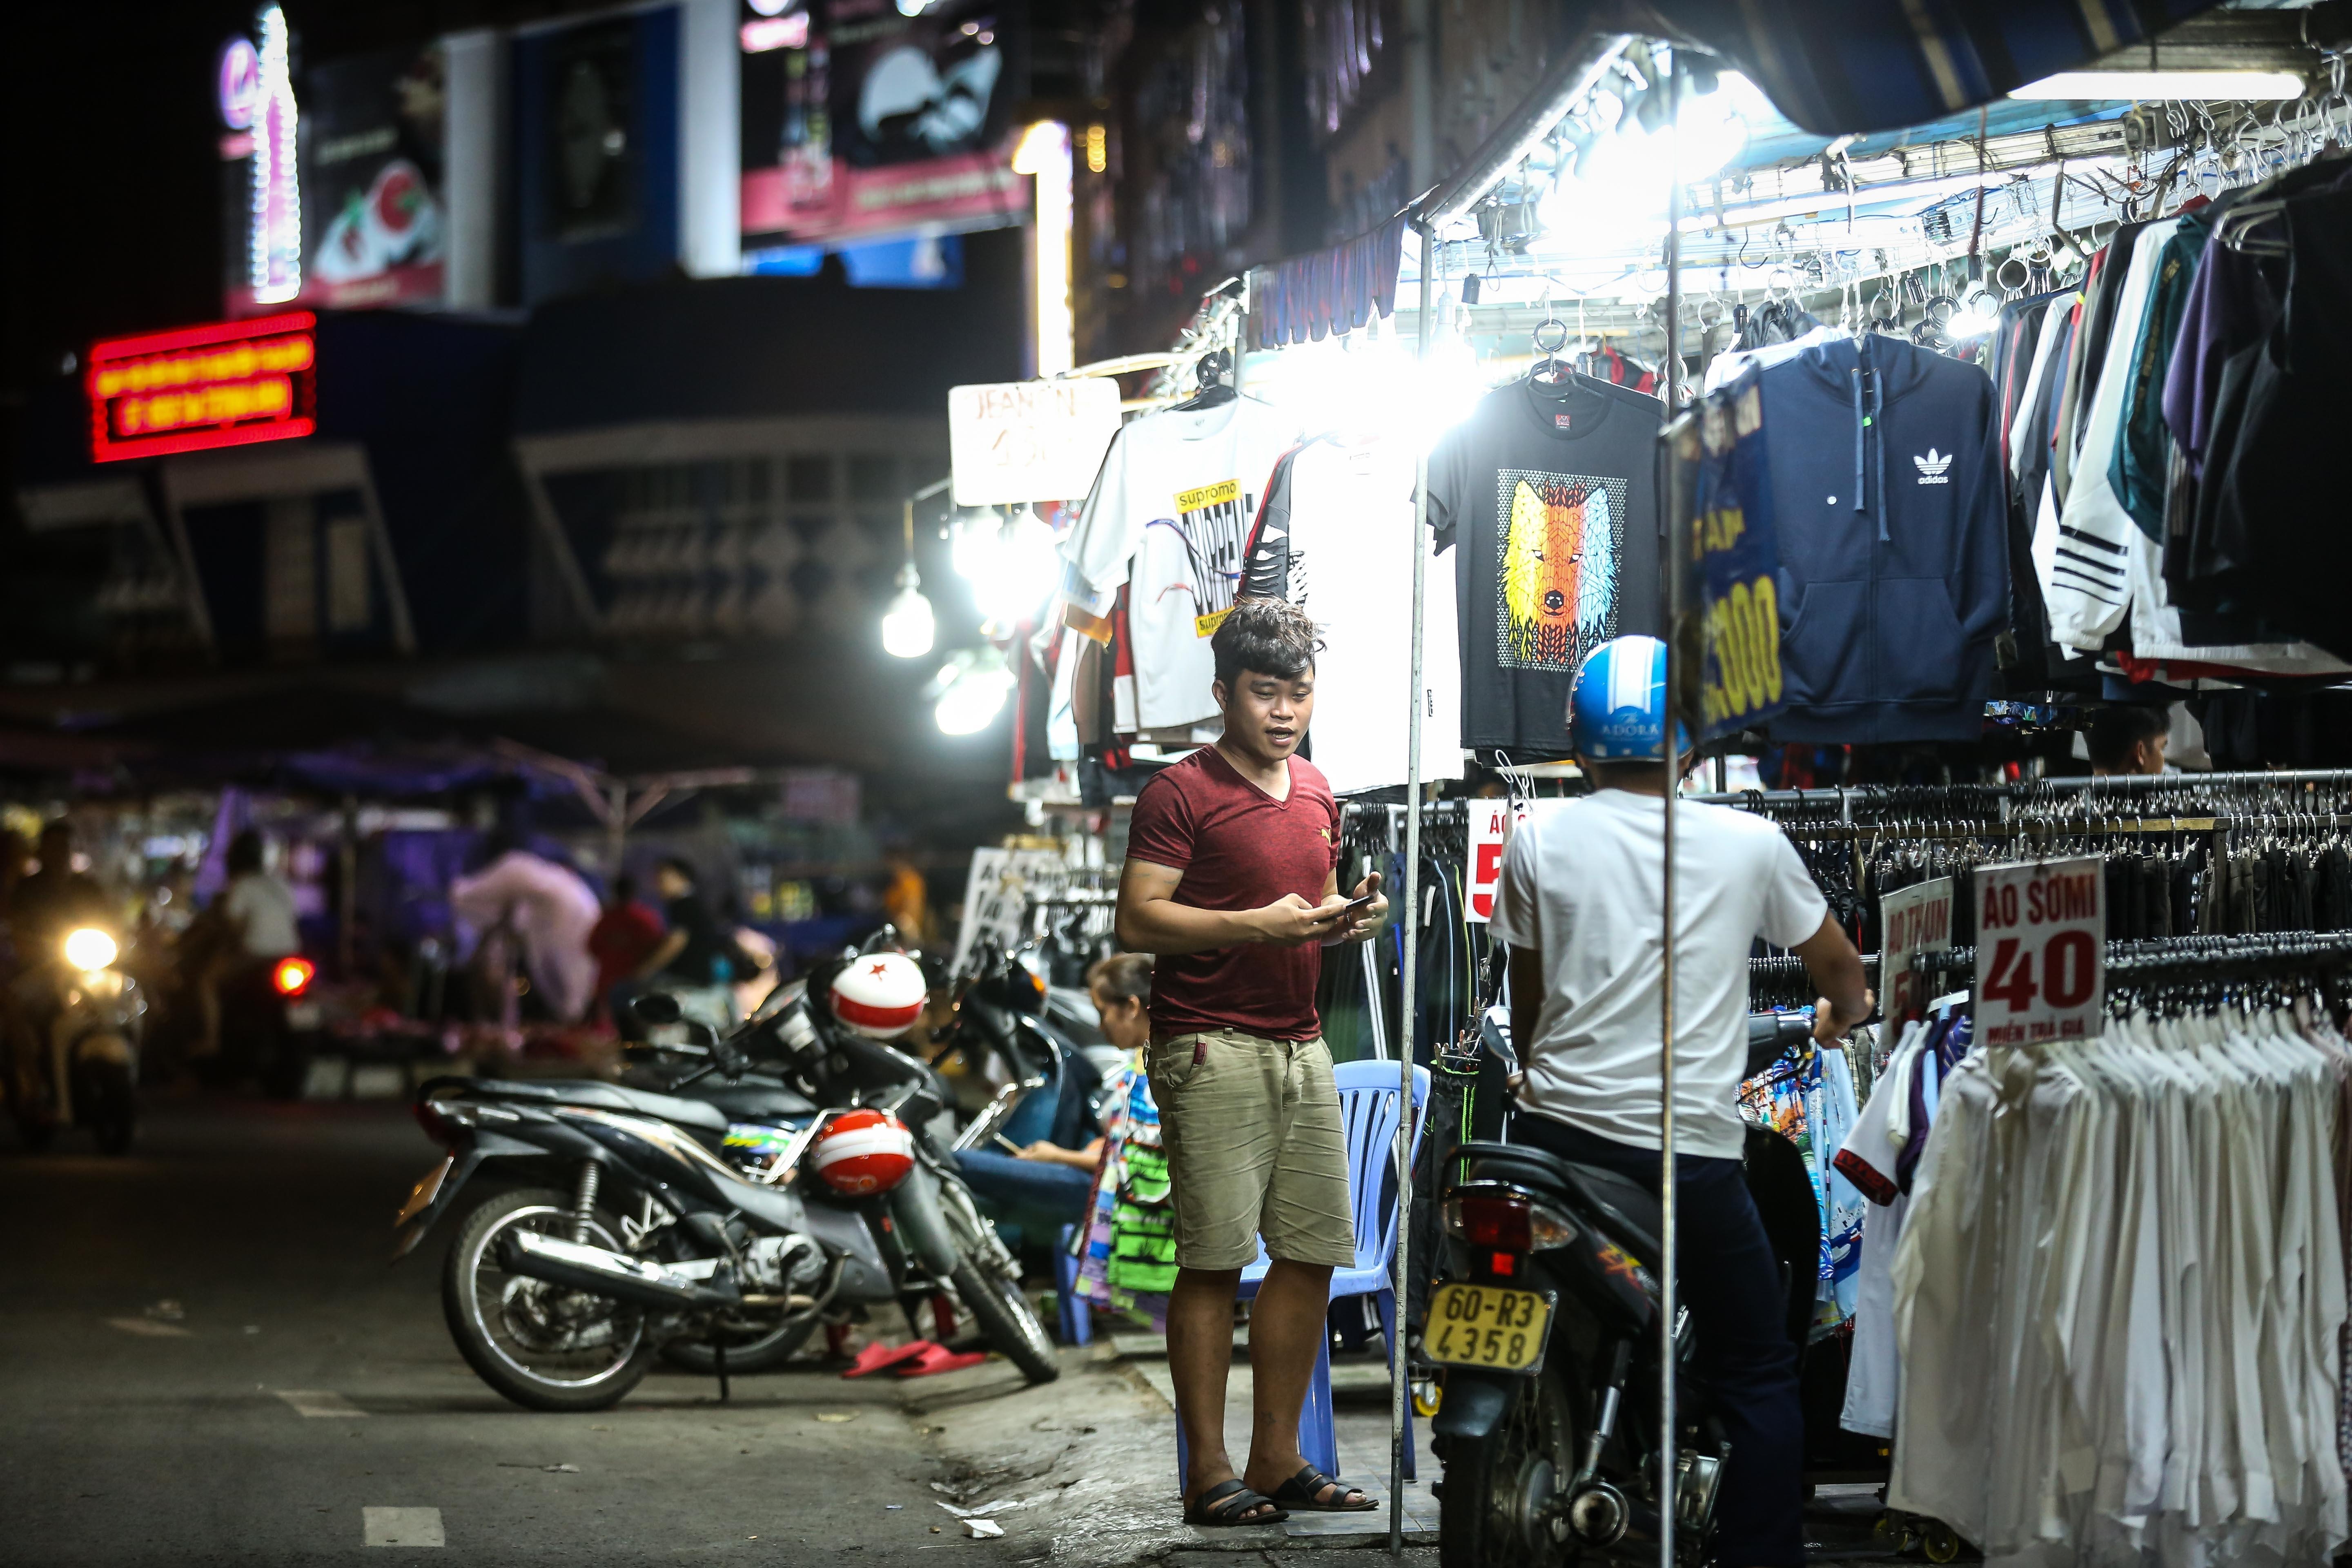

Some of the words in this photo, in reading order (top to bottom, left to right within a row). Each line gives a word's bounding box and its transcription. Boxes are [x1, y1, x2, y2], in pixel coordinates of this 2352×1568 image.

[1179, 482, 1236, 507] supromo
[1918, 475, 1949, 485] adidas
[1601, 722, 1659, 736] ADORA
[1982, 875, 2019, 930] ÁO
[1982, 929, 2096, 1013] 40
[1446, 1287, 1536, 1329] 60-R3
[1436, 1325, 1528, 1365] 4358
